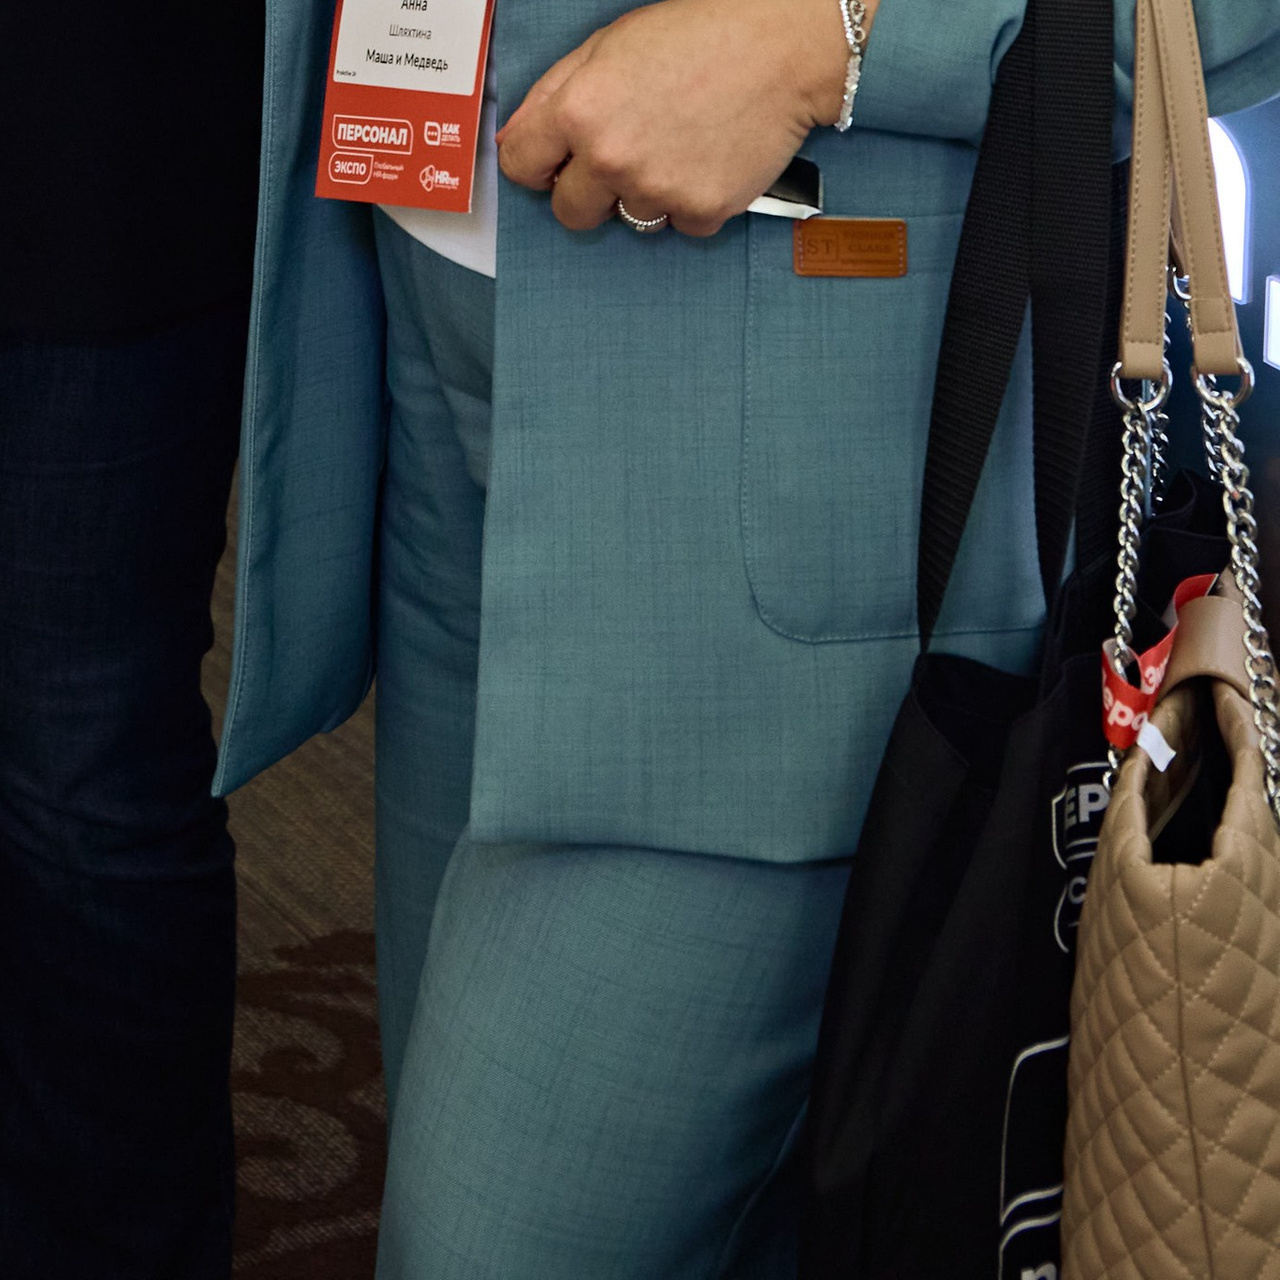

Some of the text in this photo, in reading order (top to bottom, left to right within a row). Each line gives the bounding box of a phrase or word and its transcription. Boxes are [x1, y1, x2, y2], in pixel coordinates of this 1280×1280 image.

[389, 24, 432, 40] Шляхтина
[365, 48, 449, 72] Маша и Медведь
[337, 123, 408, 146] ПЕРСОНАЛ
[441, 123, 460, 135] КАК
[334, 160, 367, 176] ЭКСПО
[434, 170, 460, 187] HRnet
